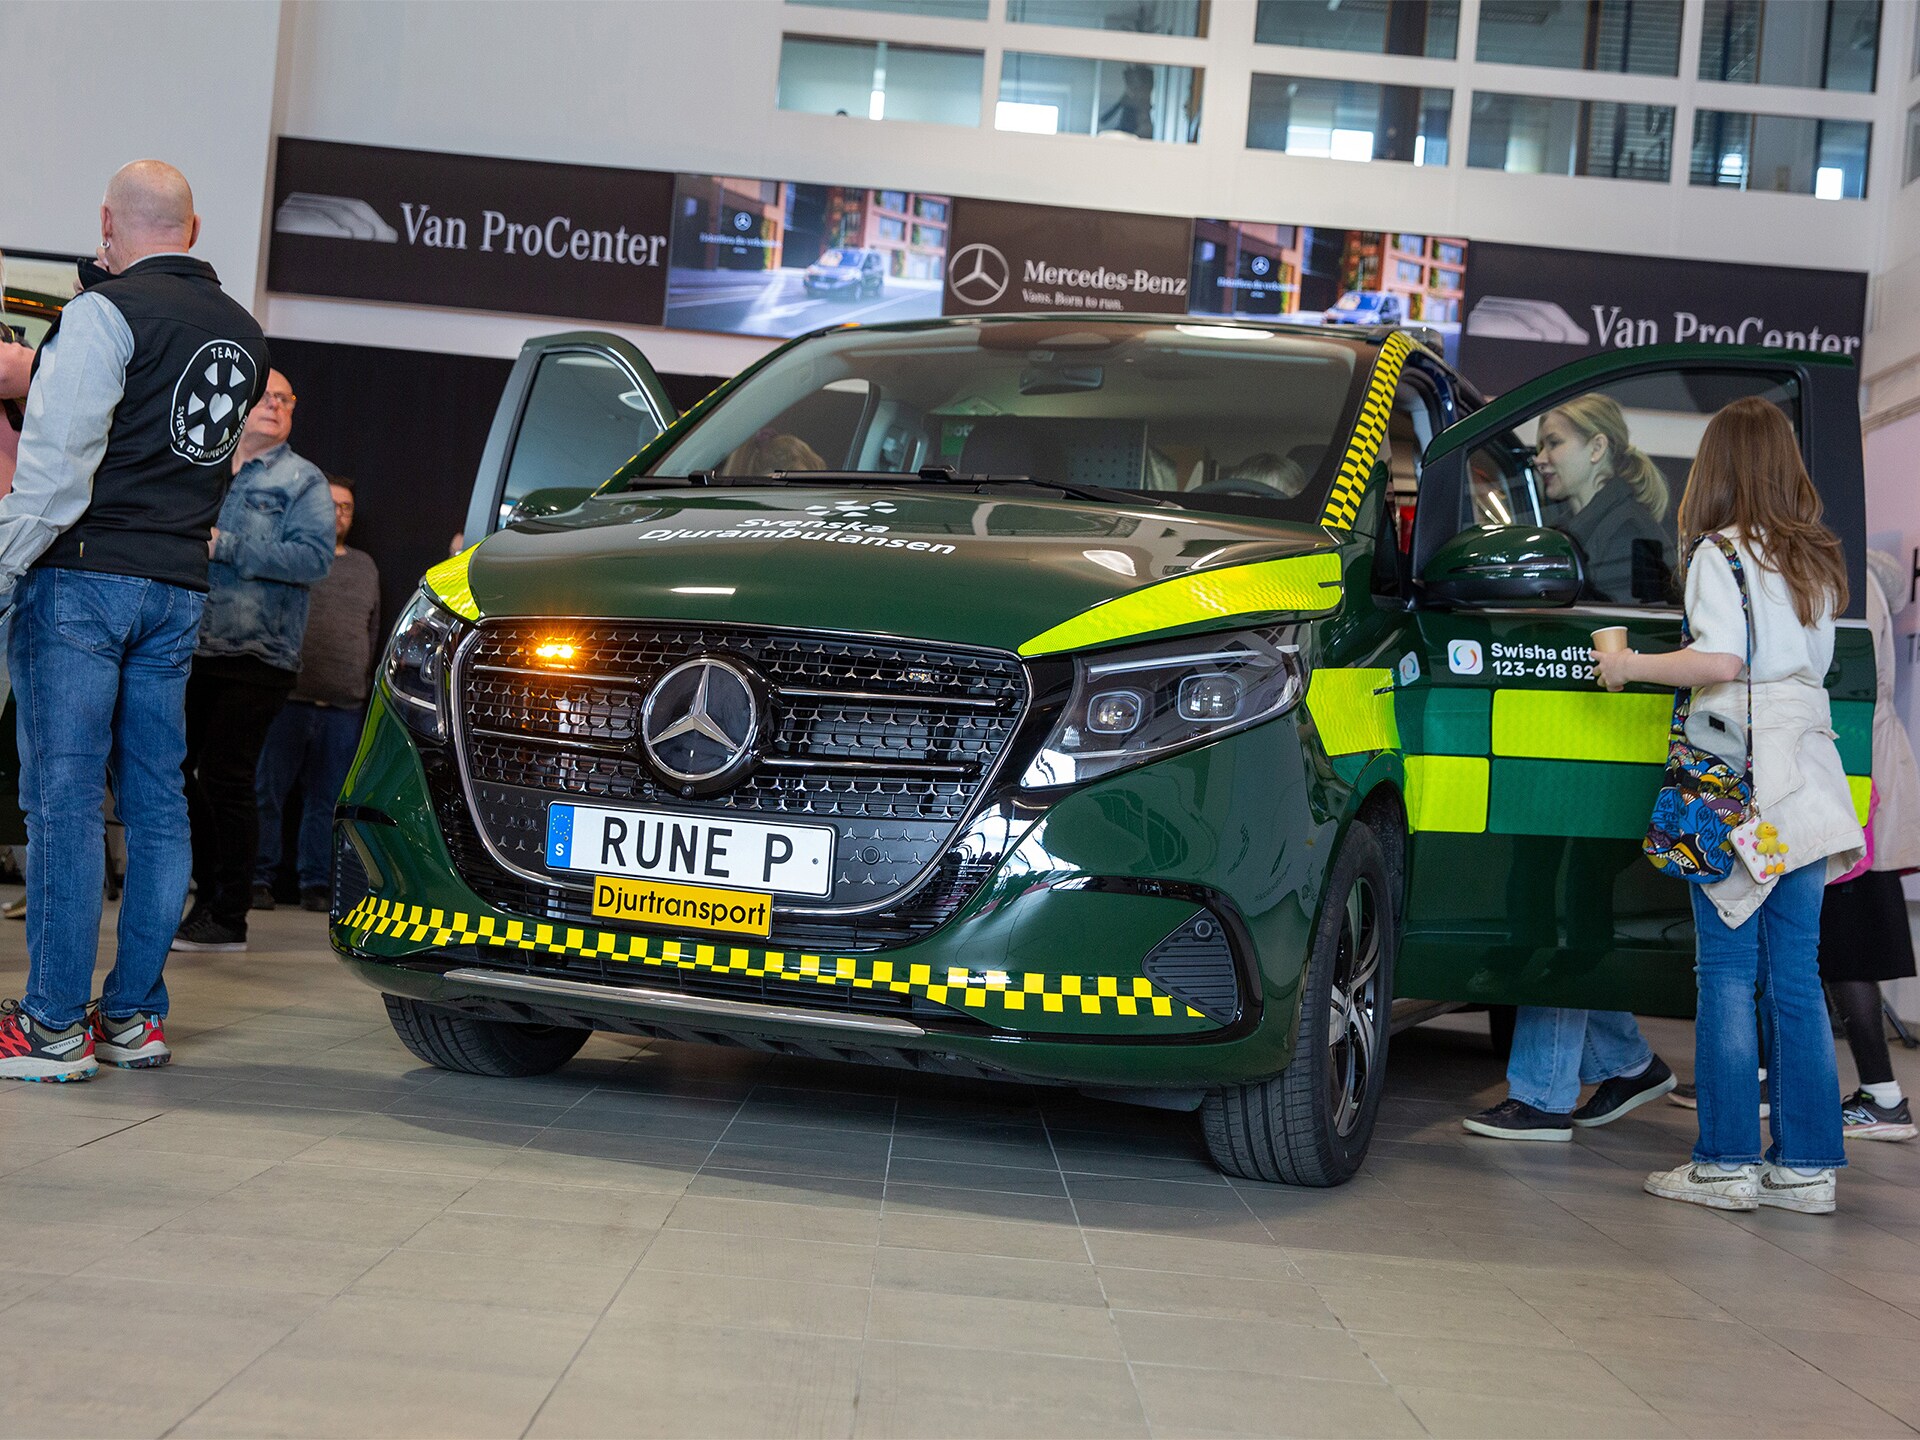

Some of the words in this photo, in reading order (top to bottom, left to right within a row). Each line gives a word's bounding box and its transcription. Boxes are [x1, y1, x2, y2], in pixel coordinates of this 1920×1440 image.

[400, 202, 467, 250] Van
[479, 210, 667, 266] ProCenter
[1022, 259, 1188, 296] Mercedes-Benz
[1021, 288, 1053, 305] Vans.
[1054, 291, 1084, 308] Born
[1085, 295, 1098, 309] to
[1591, 305, 1659, 348] Van
[1673, 312, 1860, 354] ProCenter
[210, 346, 241, 363] TEAM
[175, 405, 187, 448] SVENA
[736, 518, 890, 534] Svenska
[638, 527, 957, 555] Djurambulansen
[1490, 642, 1557, 660] Swisha
[1492, 661, 1567, 679] 123-618
[1571, 664, 1596, 680] 82
[555, 843, 564, 857] S
[600, 816, 733, 879] RUNE
[762, 833, 794, 883] P
[598, 885, 766, 926] Djurtransport
[49, 1037, 80, 1051] MERRELL
